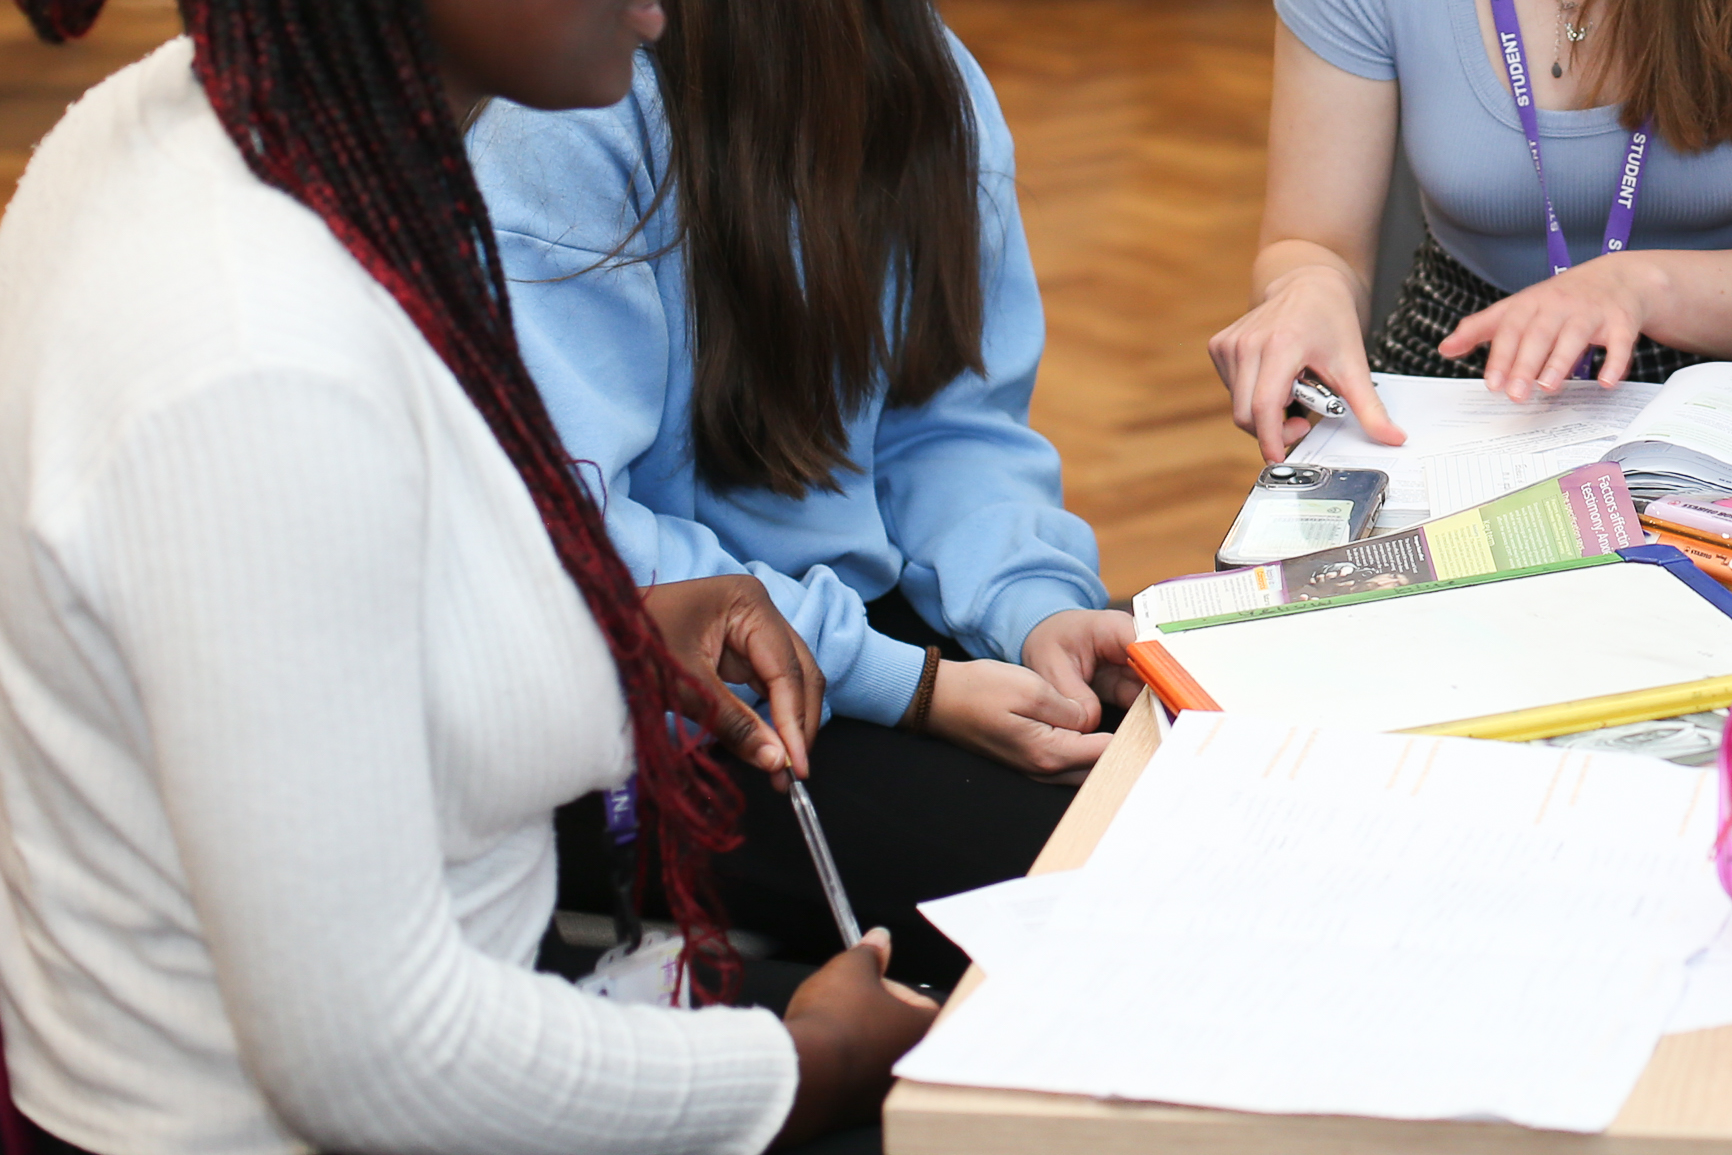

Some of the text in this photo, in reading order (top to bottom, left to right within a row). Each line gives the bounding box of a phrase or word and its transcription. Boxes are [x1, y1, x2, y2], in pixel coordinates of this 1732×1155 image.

[1500, 32, 1530, 107] STUDENT
[1618, 132, 1646, 209] STUDENT
[1561, 490, 1570, 502] The
[1565, 502, 1581, 538] specification
[1579, 481, 1604, 534] testimony:
[1597, 474, 1631, 549] Factors affectin
[1682, 502, 1717, 515] STABILO
